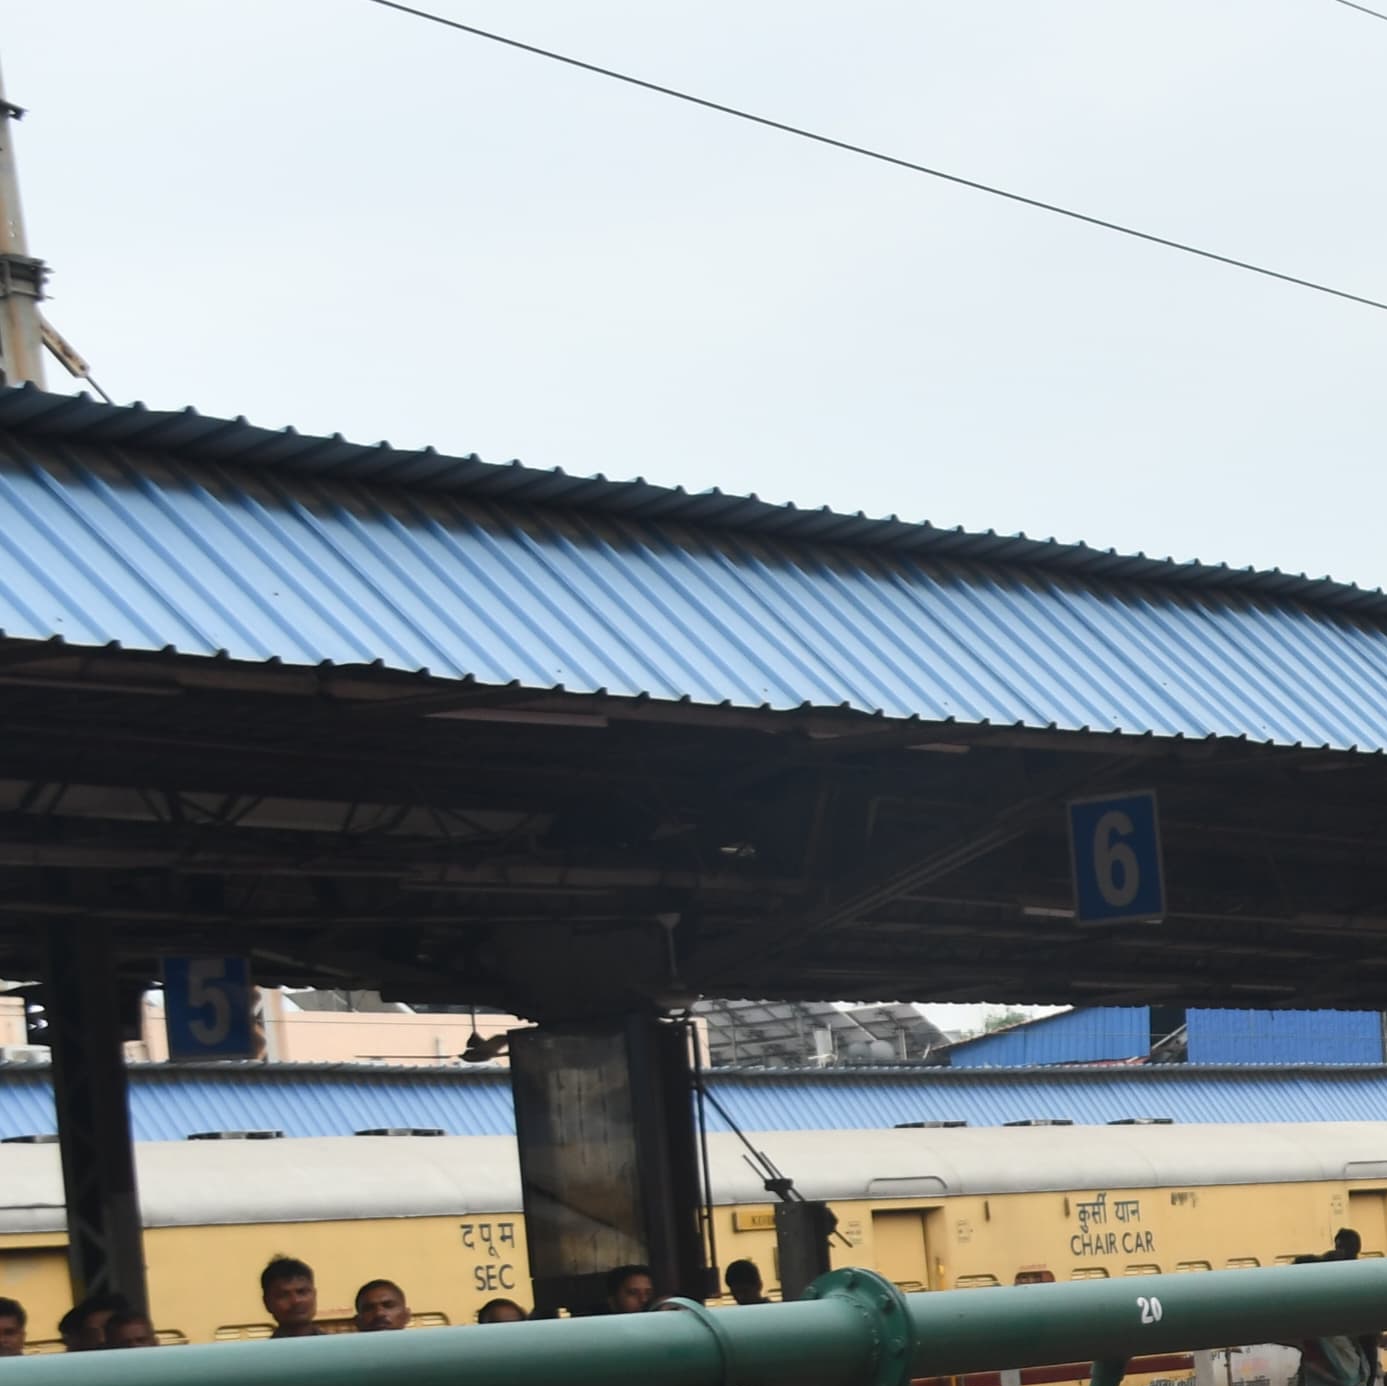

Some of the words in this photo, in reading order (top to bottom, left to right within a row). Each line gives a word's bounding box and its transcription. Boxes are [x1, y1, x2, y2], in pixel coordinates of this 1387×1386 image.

[1093, 809, 1140, 907] 6
[187, 957, 231, 1046] 5
[1076, 1192, 1107, 1233] कुर्सी
[1113, 1200, 1140, 1223] यान
[1070, 1233, 1118, 1256] CHAIR
[1122, 1230, 1155, 1254] CAR
[474, 1264, 515, 1291] SEC
[1136, 1296, 1163, 1324] 20
